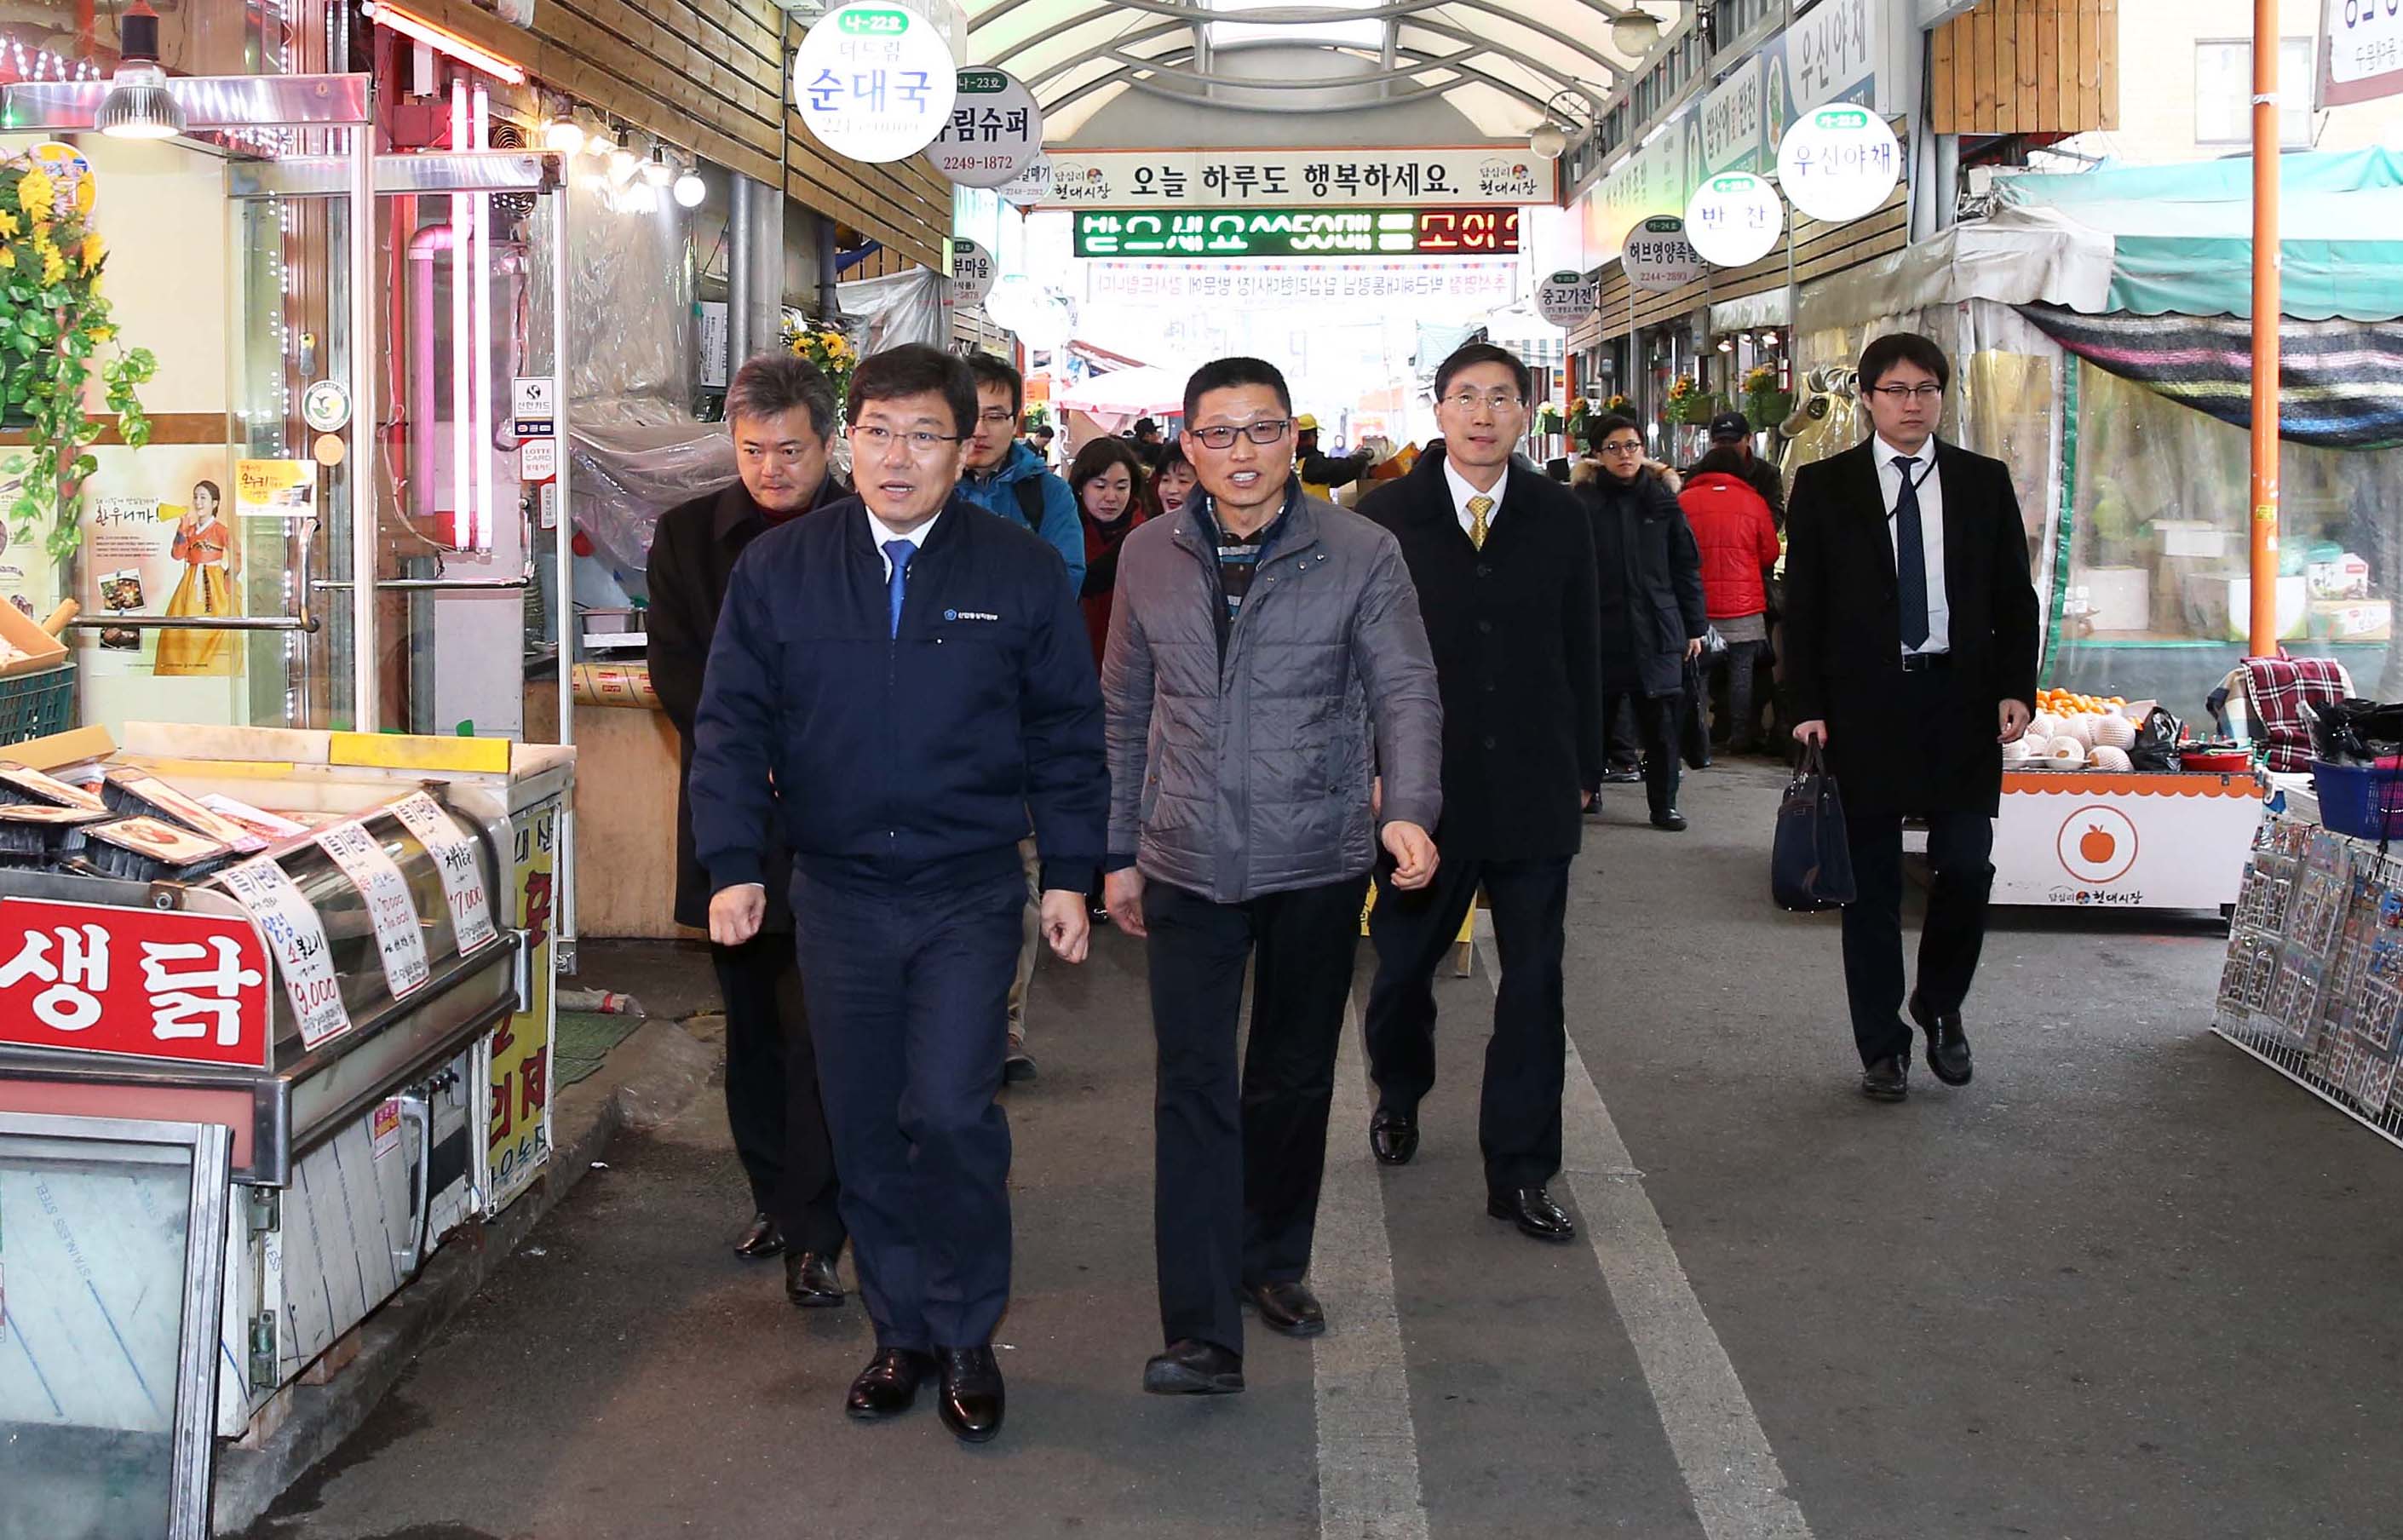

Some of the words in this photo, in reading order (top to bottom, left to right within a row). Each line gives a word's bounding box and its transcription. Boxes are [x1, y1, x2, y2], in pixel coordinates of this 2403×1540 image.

[1800, 0, 1865, 101] 우신야채
[807, 68, 933, 114] 순대국
[944, 156, 1013, 170] 2249-1872
[1792, 143, 1891, 176] 우신야채
[1055, 183, 1111, 199] 현대시장
[1130, 166, 1187, 198] 오늘
[1202, 165, 1289, 198] 하루도
[1303, 164, 1459, 197] 행복하세요.
[1480, 181, 1537, 195] 현대시장
[1700, 204, 1766, 231] 반찬
[1543, 288, 1591, 305] 중고가전
[2093, 889, 2143, 905] 현대시장
